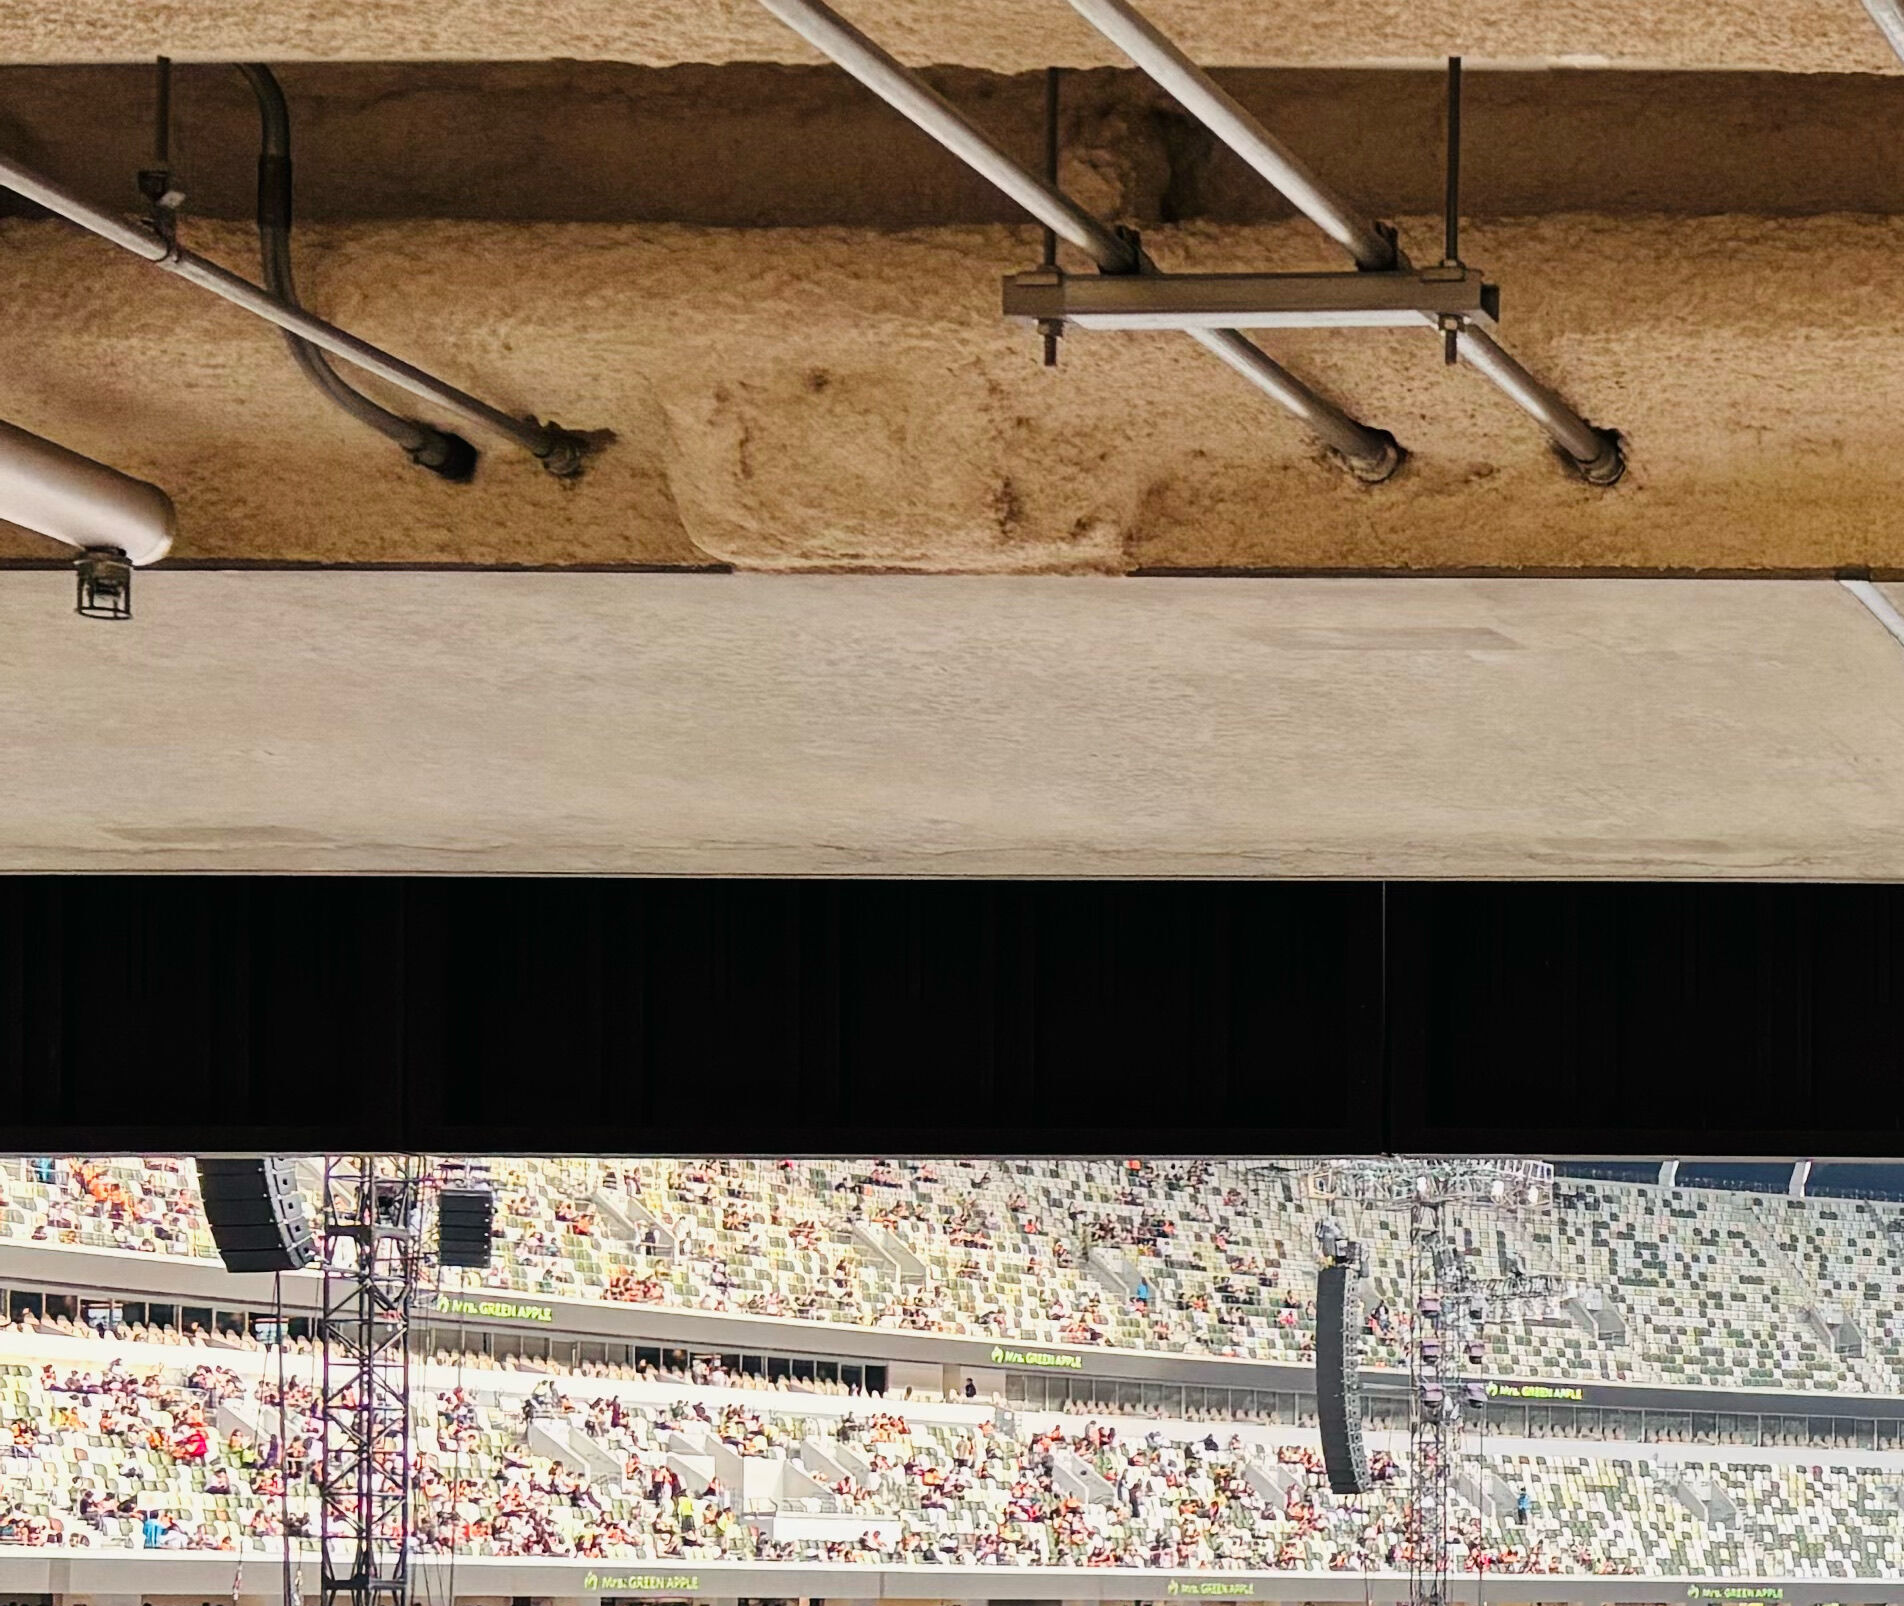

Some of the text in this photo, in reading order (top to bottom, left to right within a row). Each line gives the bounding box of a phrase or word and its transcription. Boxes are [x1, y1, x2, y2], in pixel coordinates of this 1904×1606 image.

[479, 1301, 516, 1318] GREEN
[517, 1305, 552, 1322] APPLE
[1055, 1355, 1082, 1369] APPLE
[628, 1575, 664, 1590] GREEN
[665, 1576, 698, 1590] APPLE
